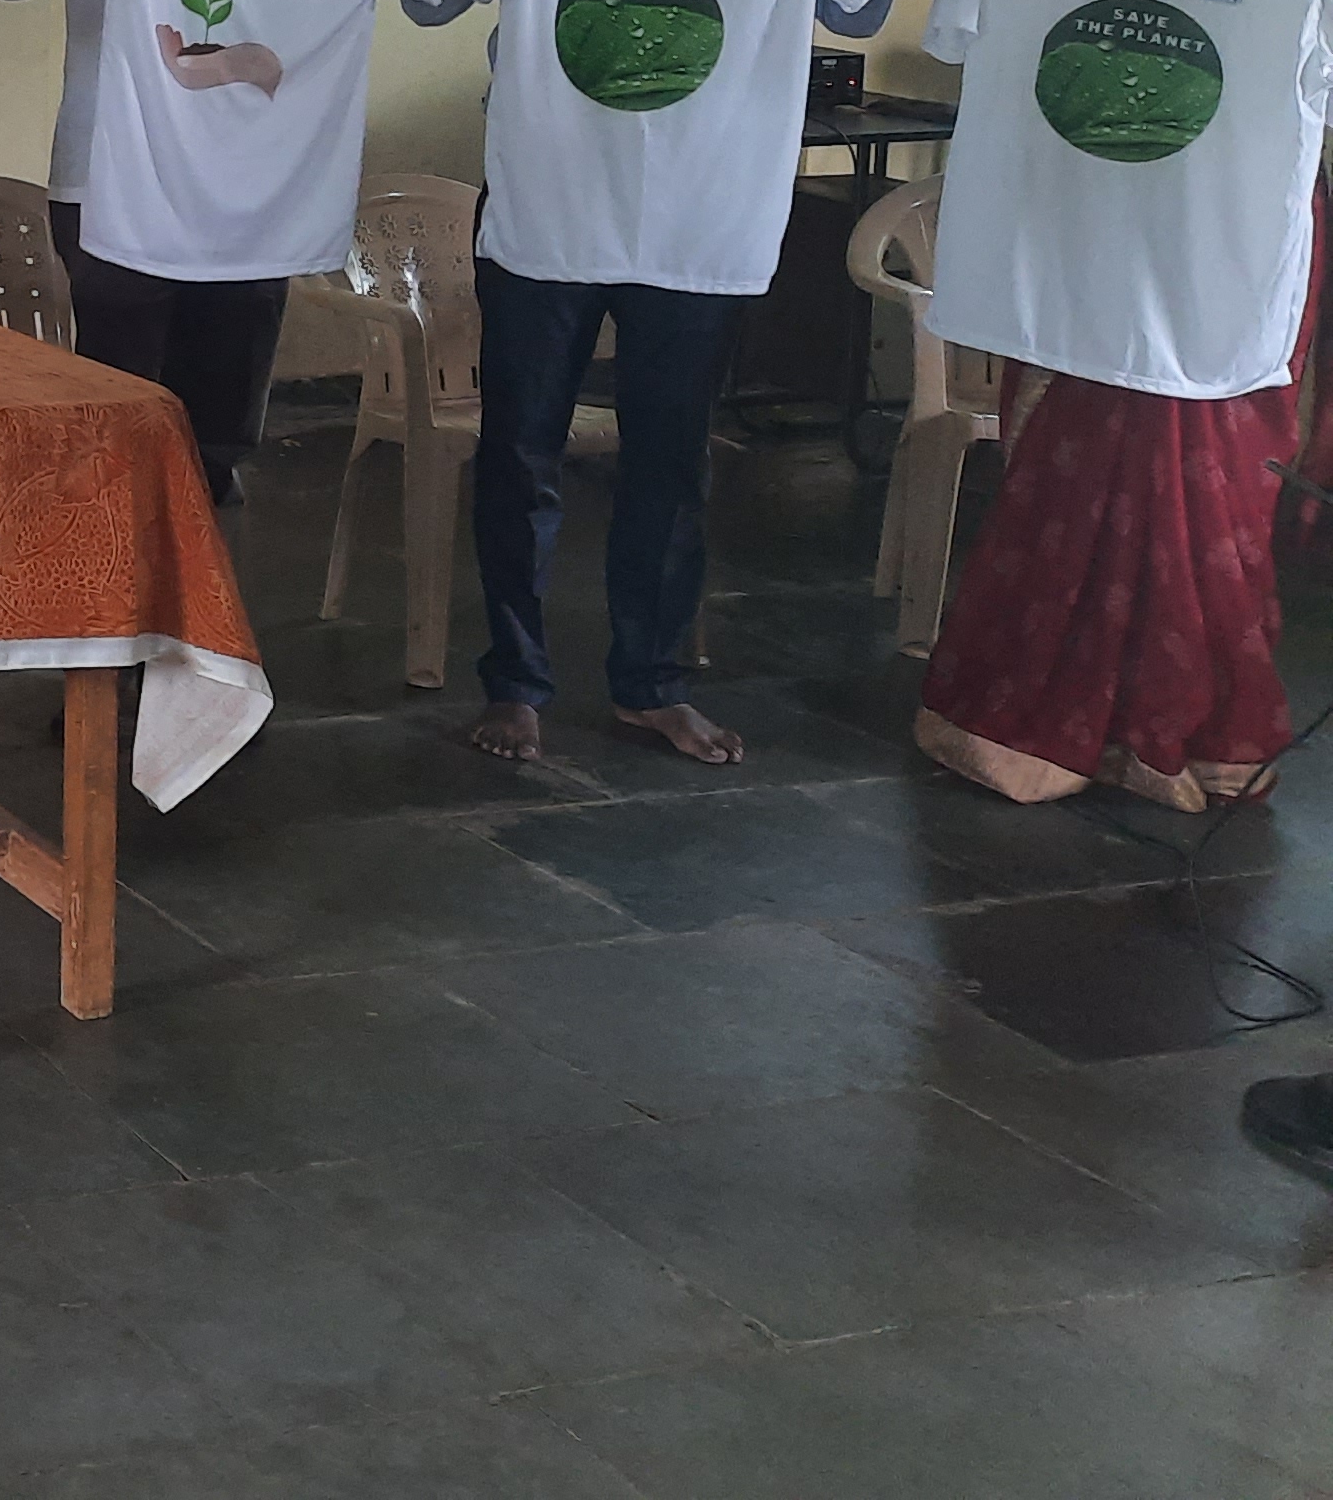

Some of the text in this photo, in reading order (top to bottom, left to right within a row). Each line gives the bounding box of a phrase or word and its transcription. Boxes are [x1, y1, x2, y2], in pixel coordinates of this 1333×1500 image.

[1113, 8, 1170, 29] SAVE
[1075, 18, 1206, 53] THE PLANET
